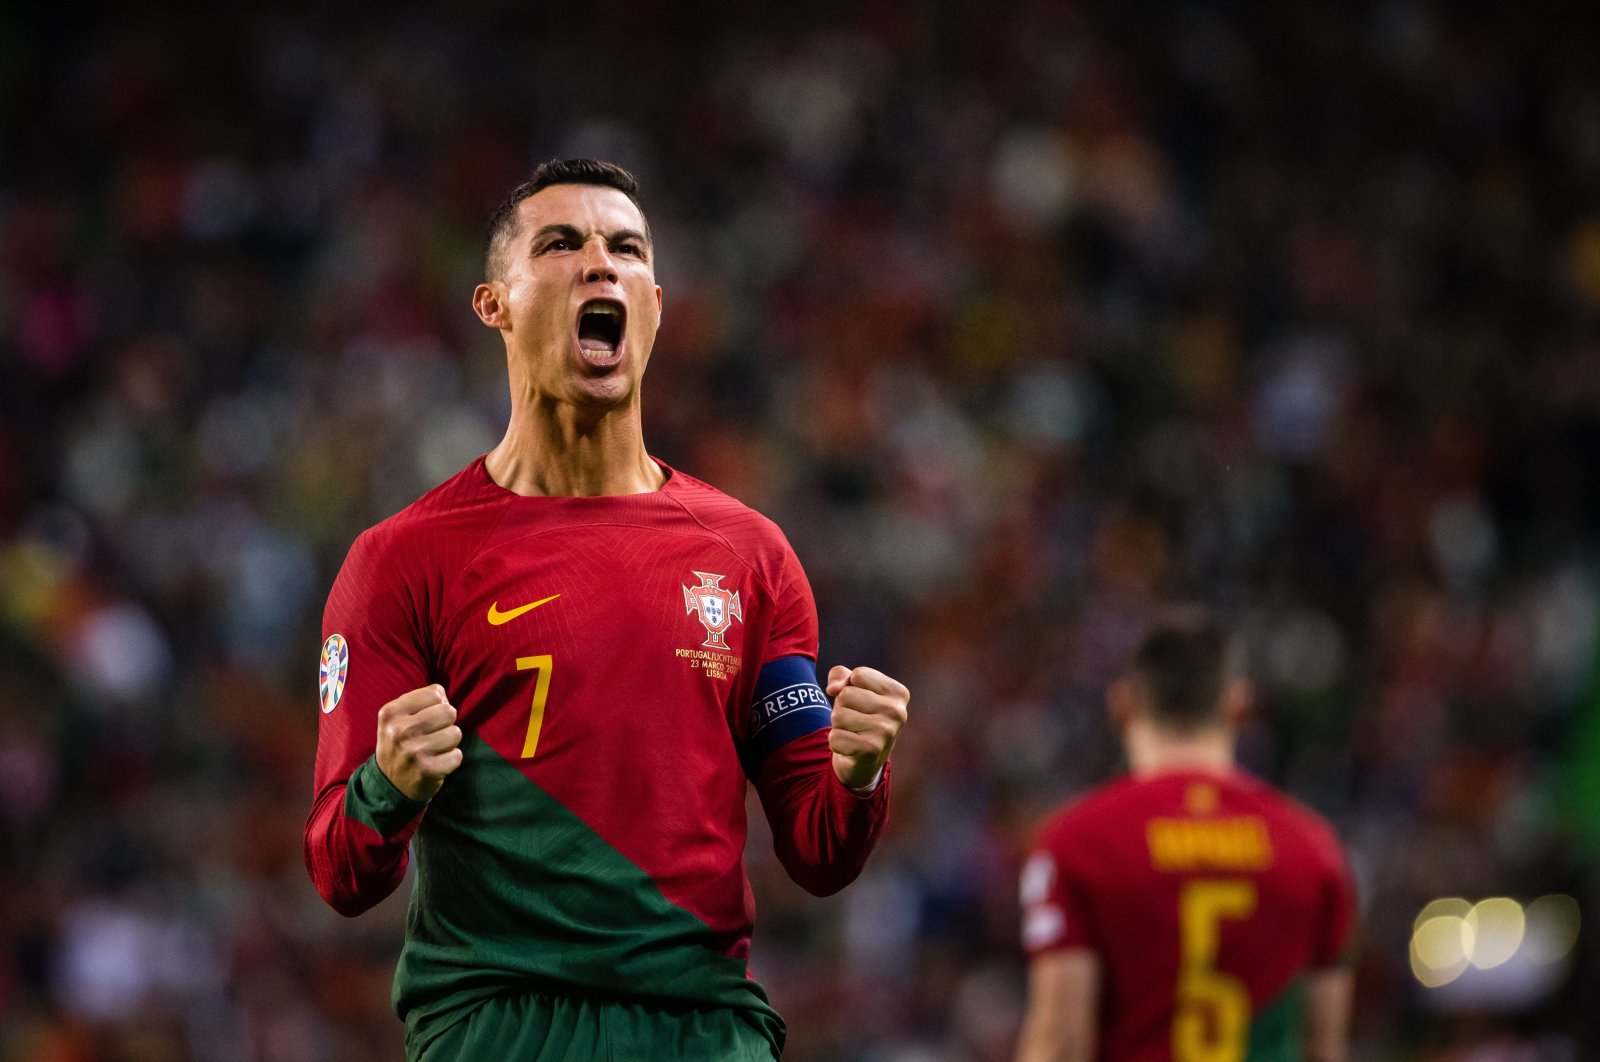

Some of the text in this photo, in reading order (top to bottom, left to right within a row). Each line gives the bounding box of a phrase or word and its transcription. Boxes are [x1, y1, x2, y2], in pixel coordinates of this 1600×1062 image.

[690, 659, 699, 668] 23
[706, 668, 727, 680] LISBOA
[515, 654, 553, 759] 7
[1172, 877, 1259, 1062] 5
